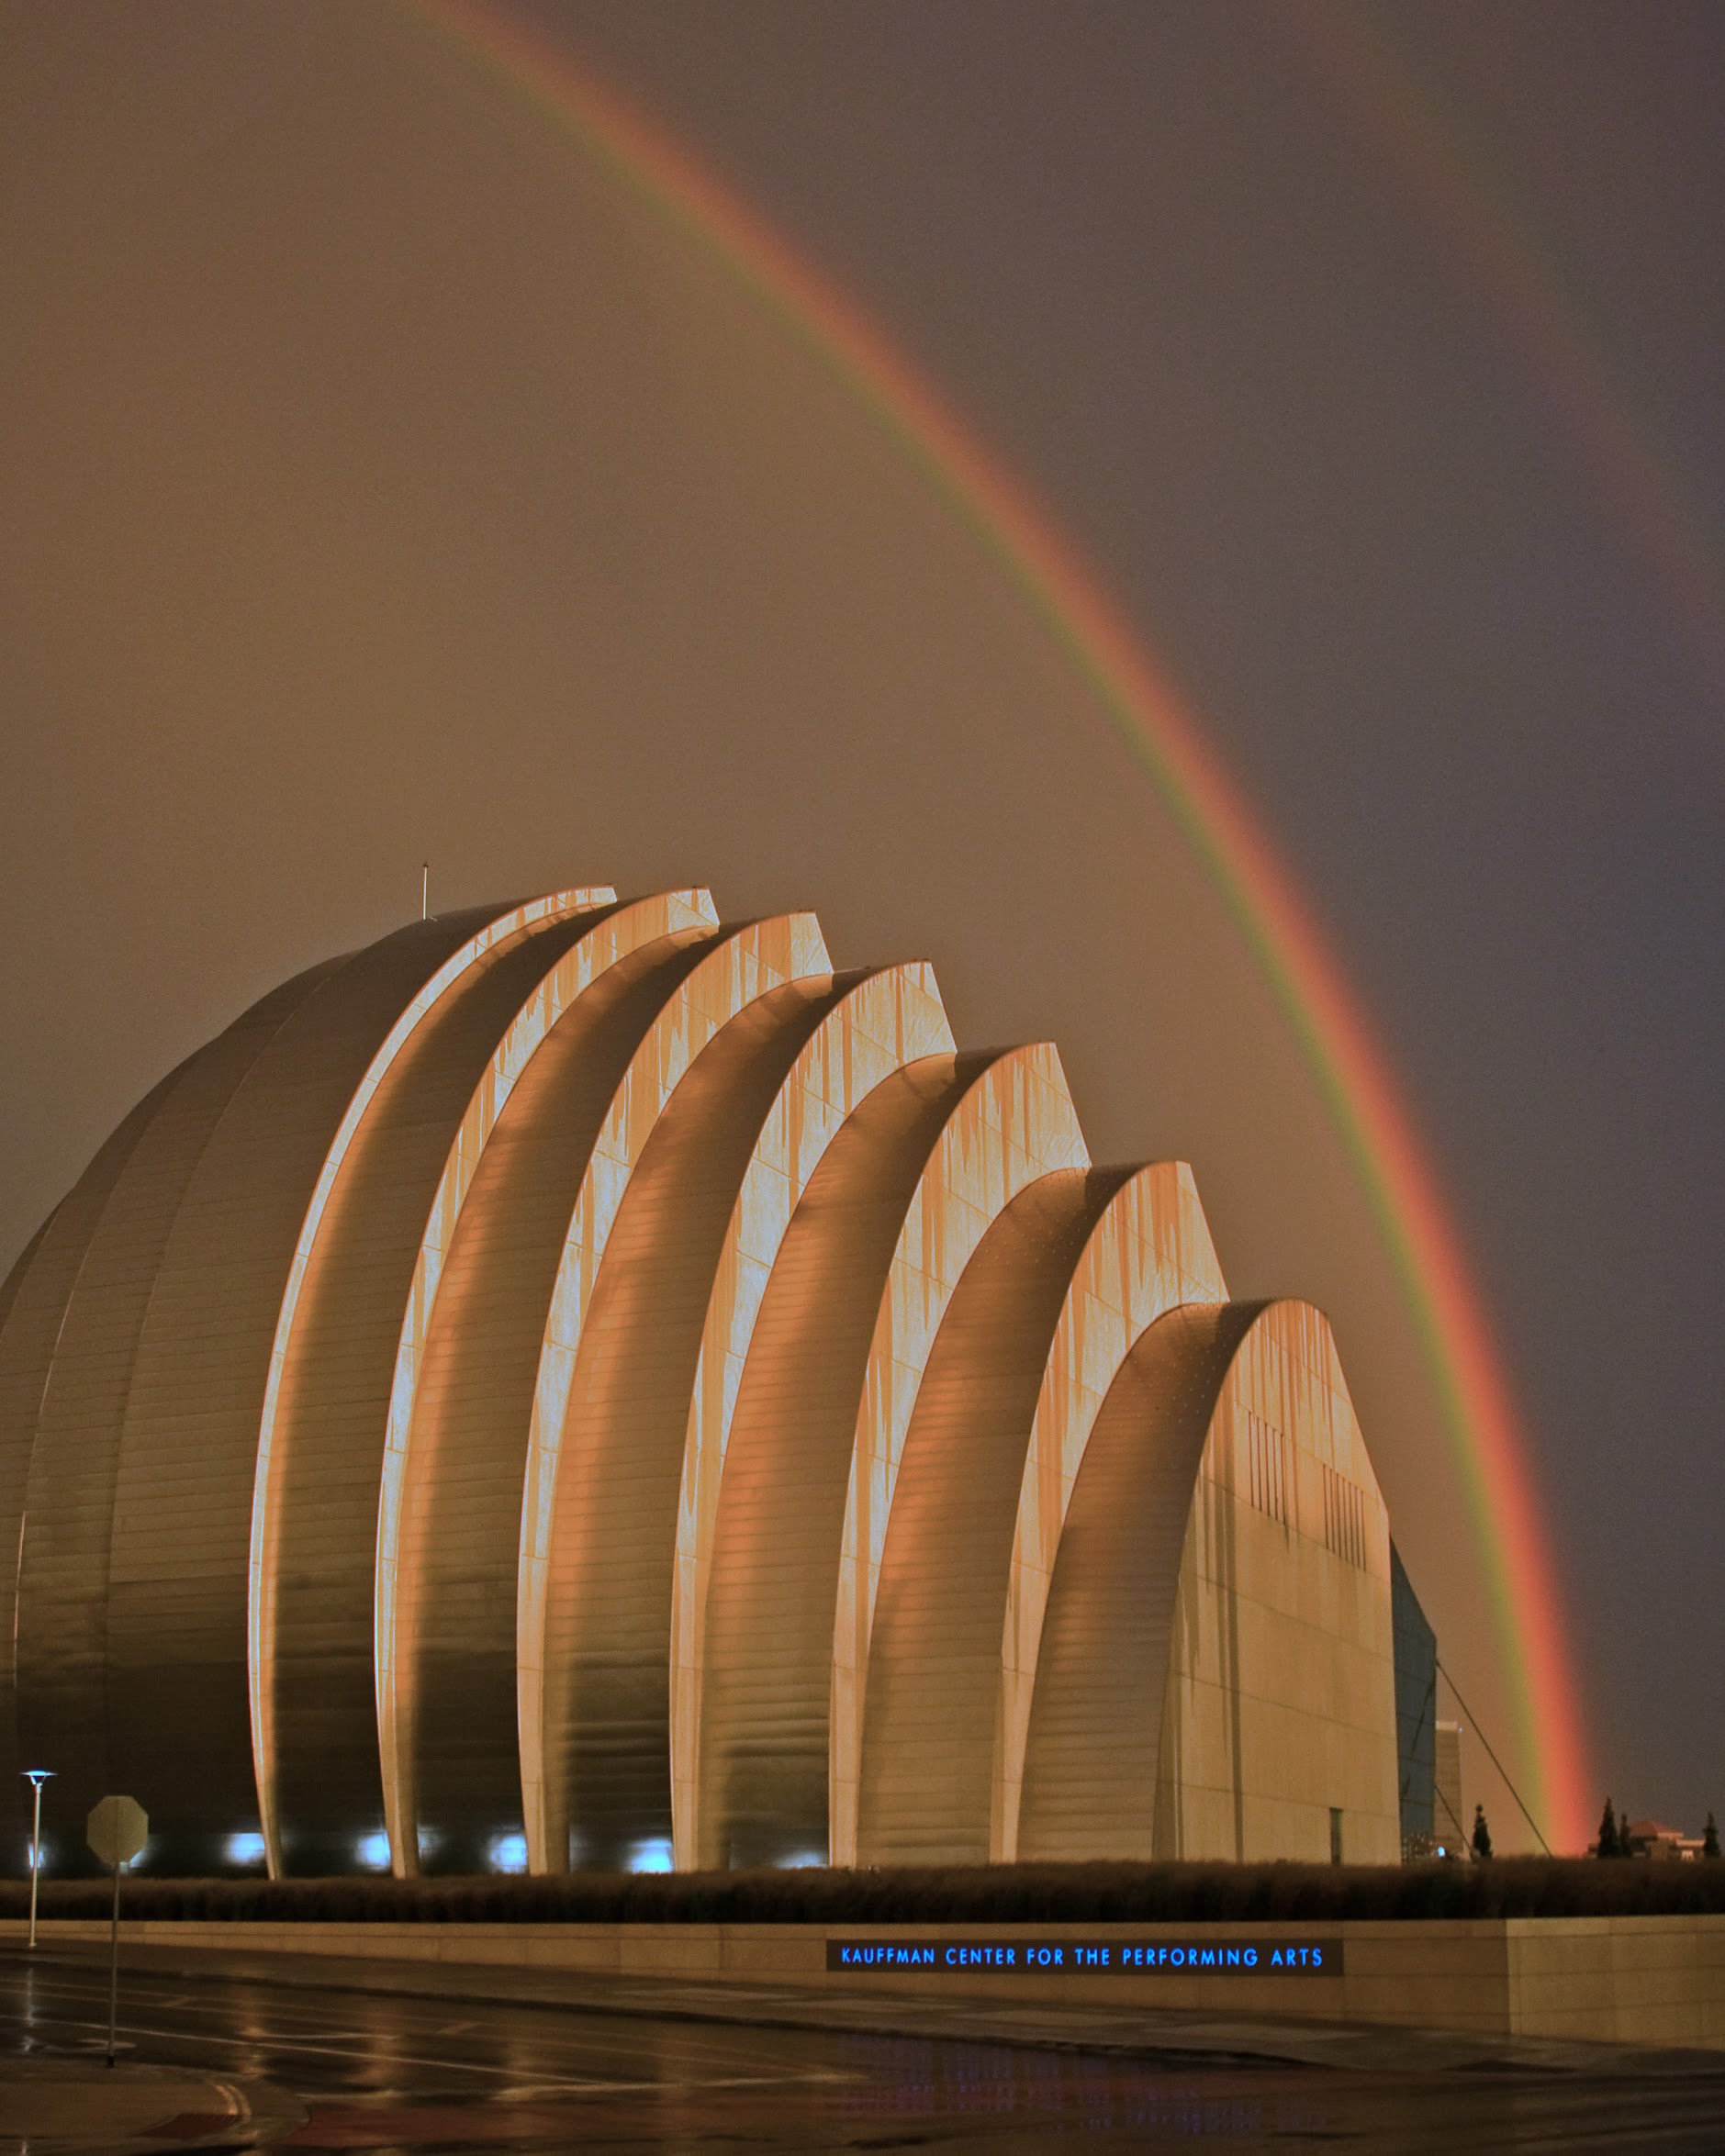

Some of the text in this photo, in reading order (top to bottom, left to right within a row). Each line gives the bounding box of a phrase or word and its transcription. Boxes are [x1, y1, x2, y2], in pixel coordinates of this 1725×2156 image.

[841, 1947, 1322, 1967] KAUFFMAN CENTER FOR THE PERFORMING ARTS
